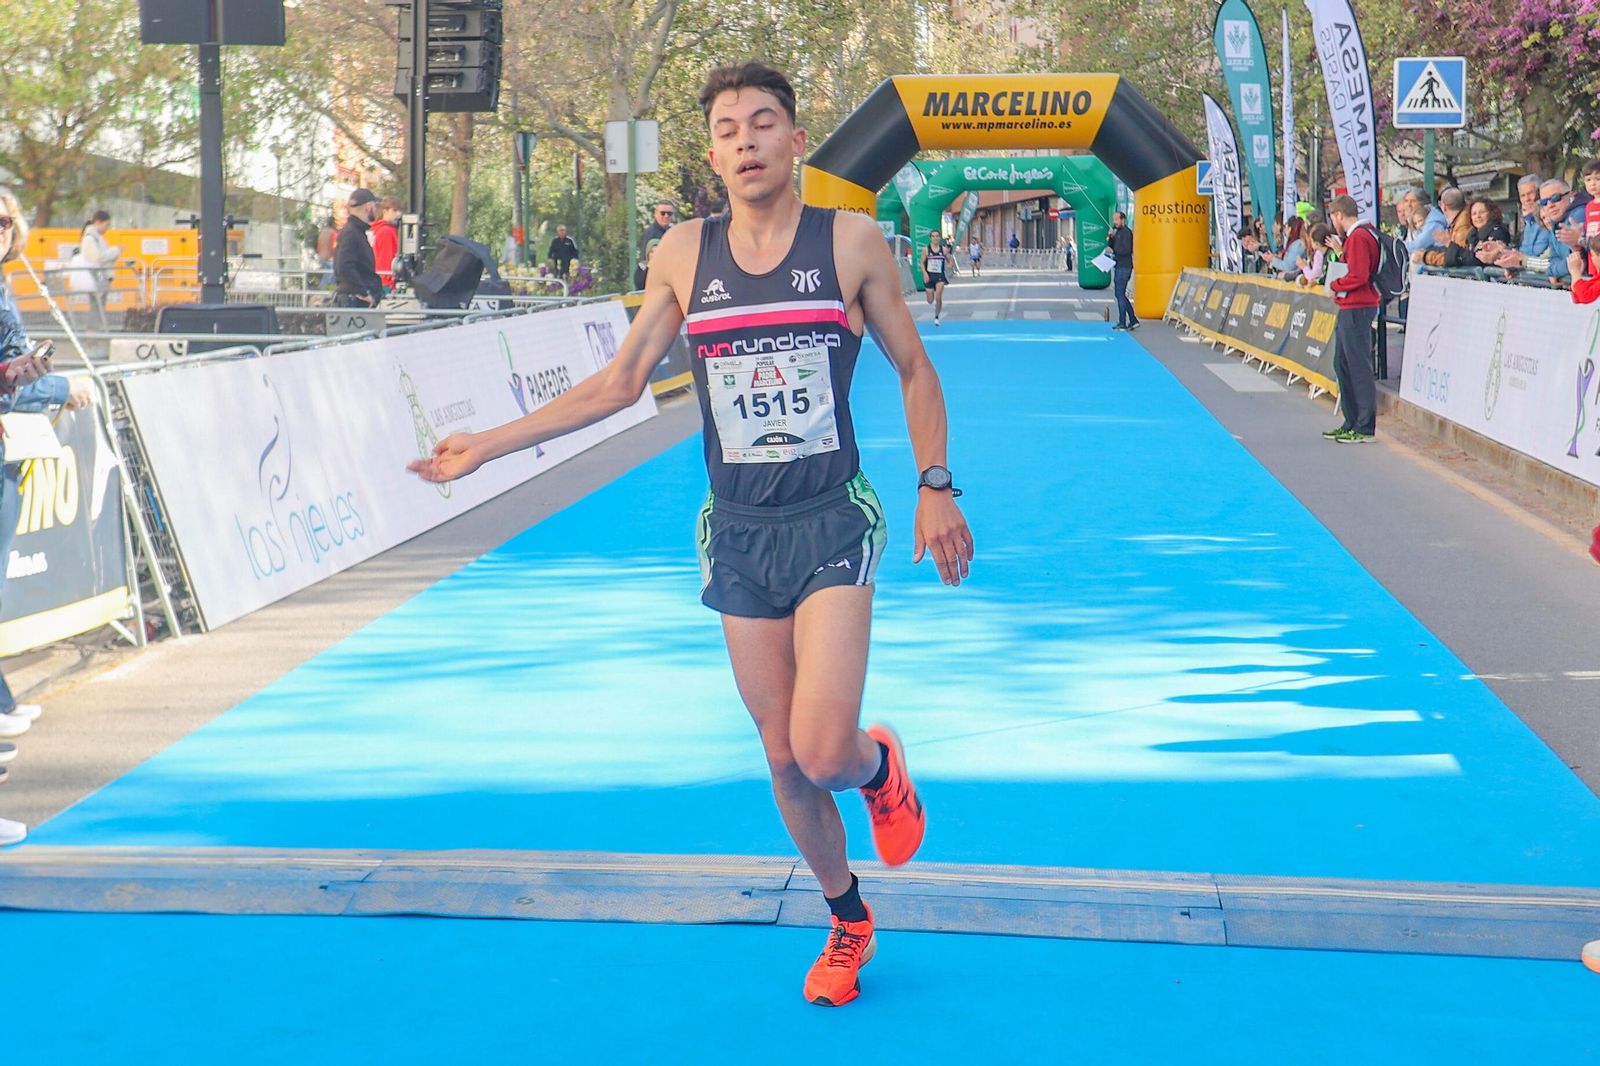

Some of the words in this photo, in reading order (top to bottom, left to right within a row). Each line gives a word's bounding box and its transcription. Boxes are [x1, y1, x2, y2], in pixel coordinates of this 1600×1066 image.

[922, 90, 1092, 117] MARCELINO
[941, 118, 1072, 132] www.mpmarcelino.es
[963, 166, 979, 180] El
[978, 166, 1009, 181] Corte
[1142, 200, 1206, 218] agustinos
[525, 364, 573, 406] PAREDES
[733, 387, 811, 420] 1515
[762, 419, 788, 428] JAVIER
